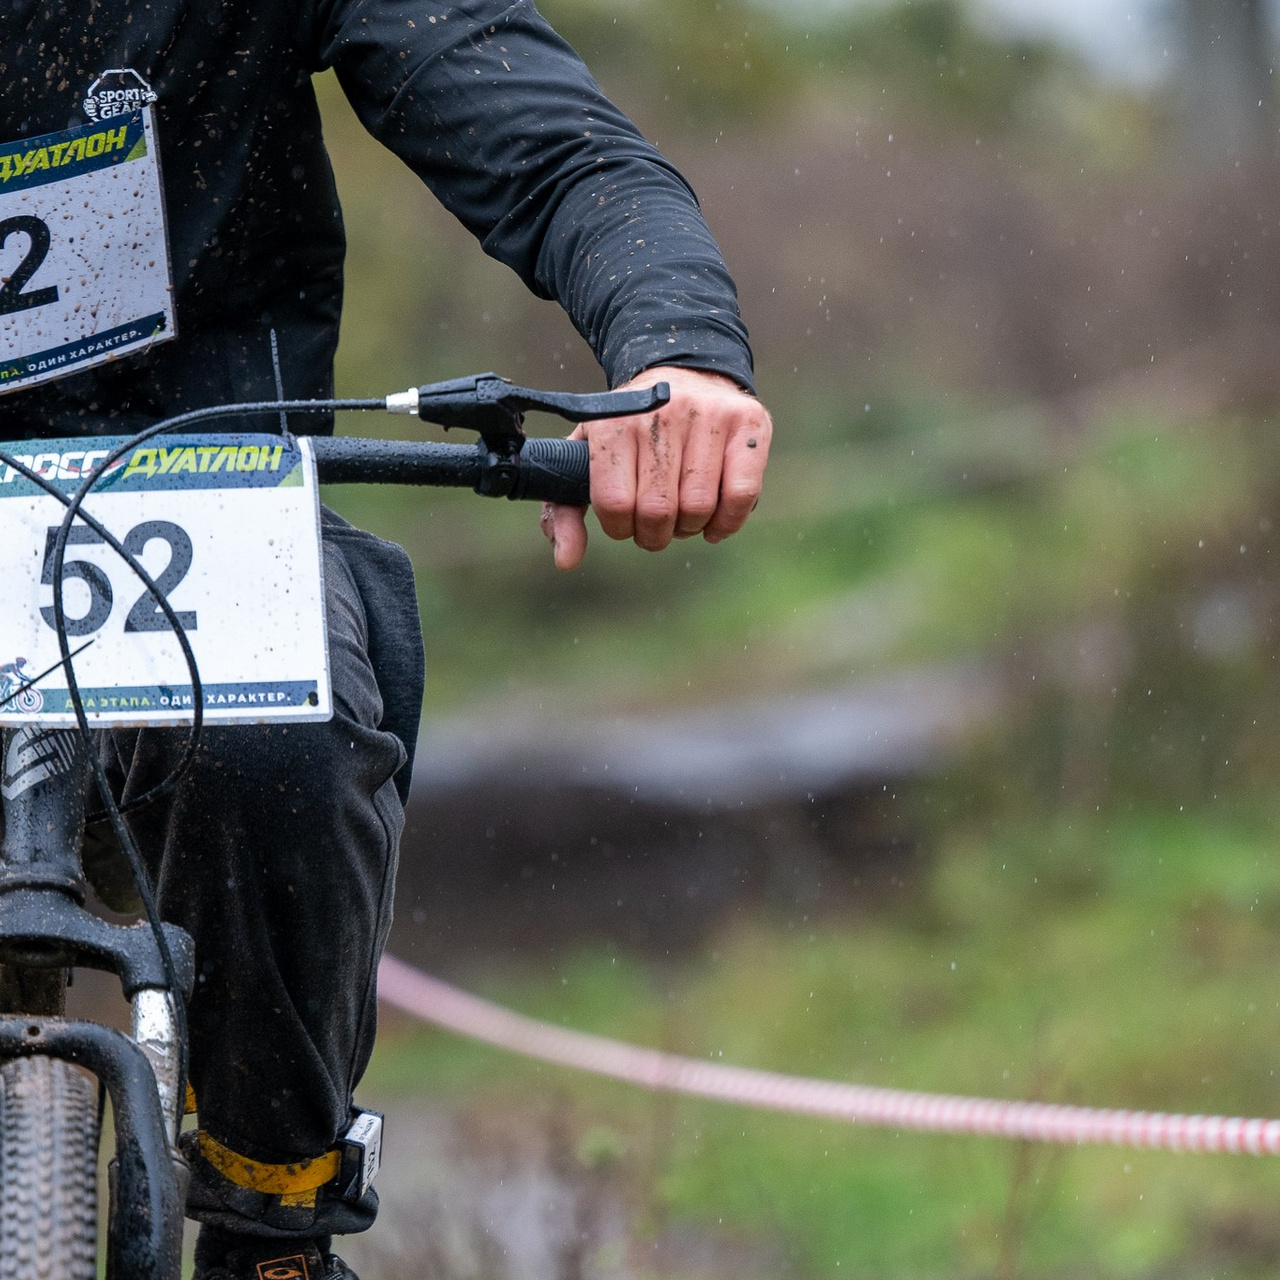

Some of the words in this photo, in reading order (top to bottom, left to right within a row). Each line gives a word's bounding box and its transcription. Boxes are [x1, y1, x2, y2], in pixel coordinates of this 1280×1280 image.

[98, 88, 140, 103] SPORT
[100, 101, 141, 119] GEAR
[27, 354, 67, 372] ОДИН
[68, 330, 143, 360] ХАРАКТЕР.
[122, 445, 284, 480] ДУАТЛОН
[39, 520, 198, 637] 52
[65, 698, 96, 710] ДА
[100, 695, 157, 708] ЭТАПА.
[159, 694, 194, 709] ОДИ
[207, 691, 292, 705] ХАРАКТЕР.
